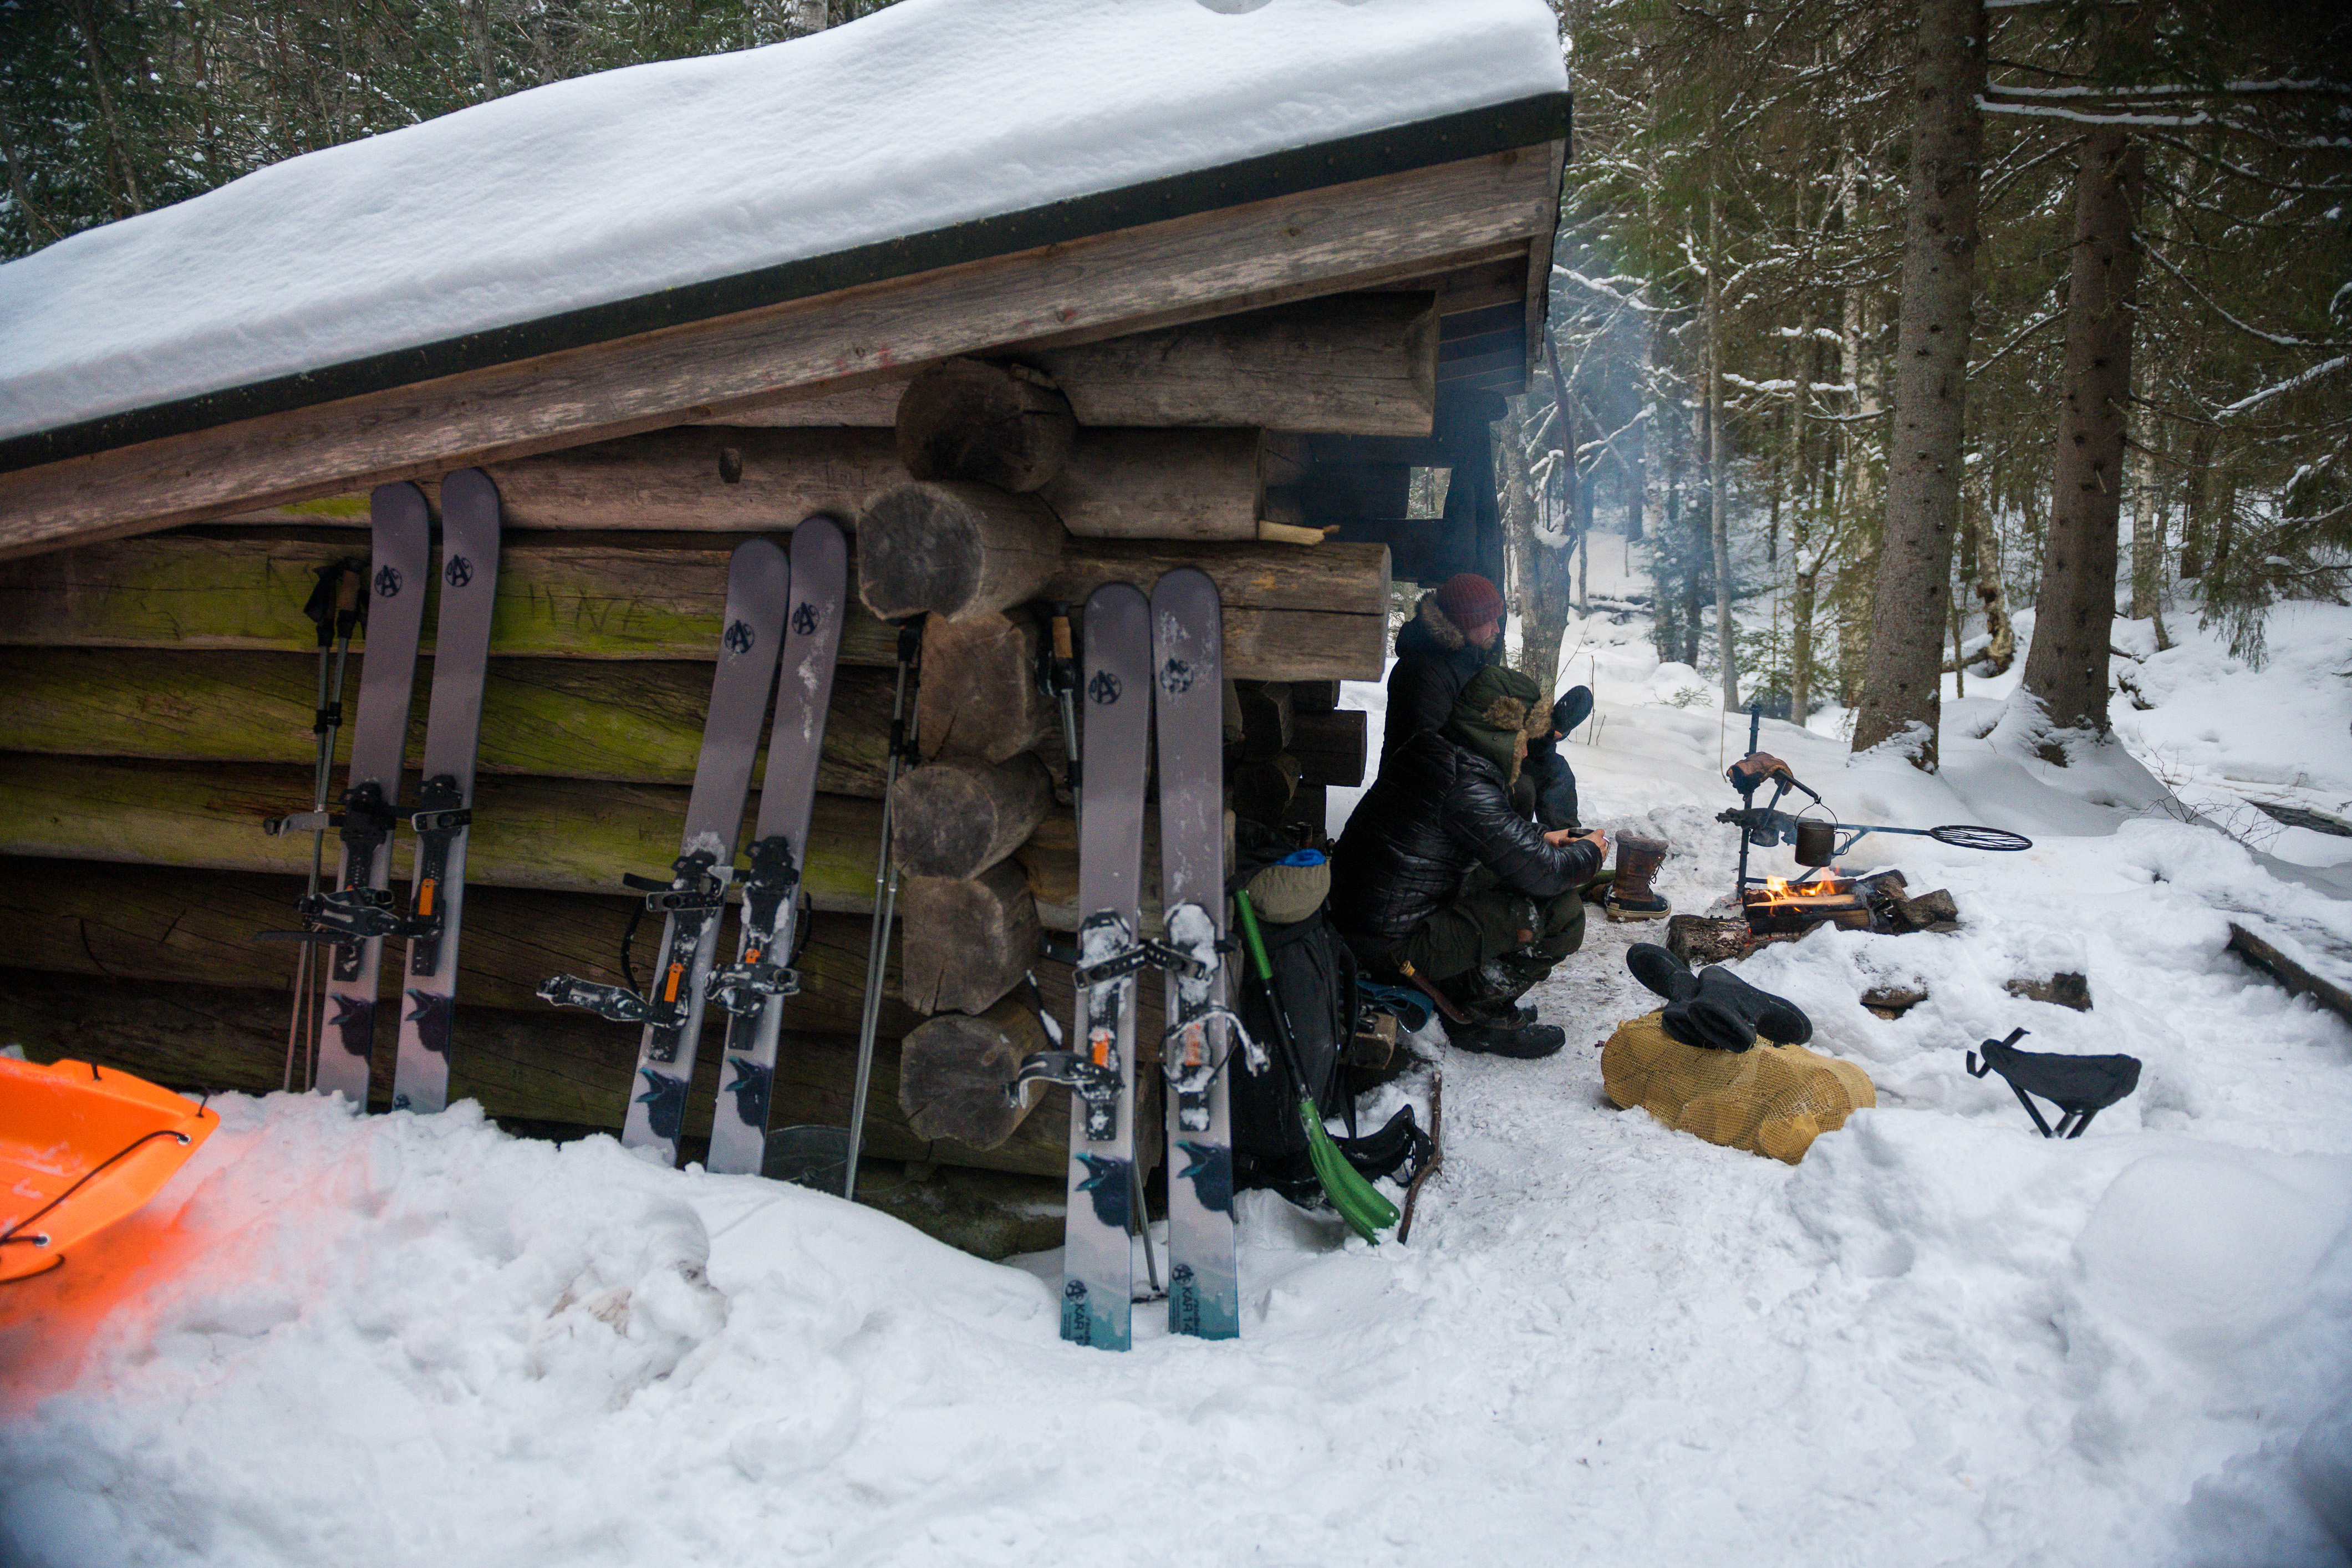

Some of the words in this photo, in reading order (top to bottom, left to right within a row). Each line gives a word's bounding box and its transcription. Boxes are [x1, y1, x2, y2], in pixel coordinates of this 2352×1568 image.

[1182, 1287, 1193, 1312] KAR
[1075, 1304, 1085, 1329] KAR
[1183, 1316, 1193, 1333] 14
